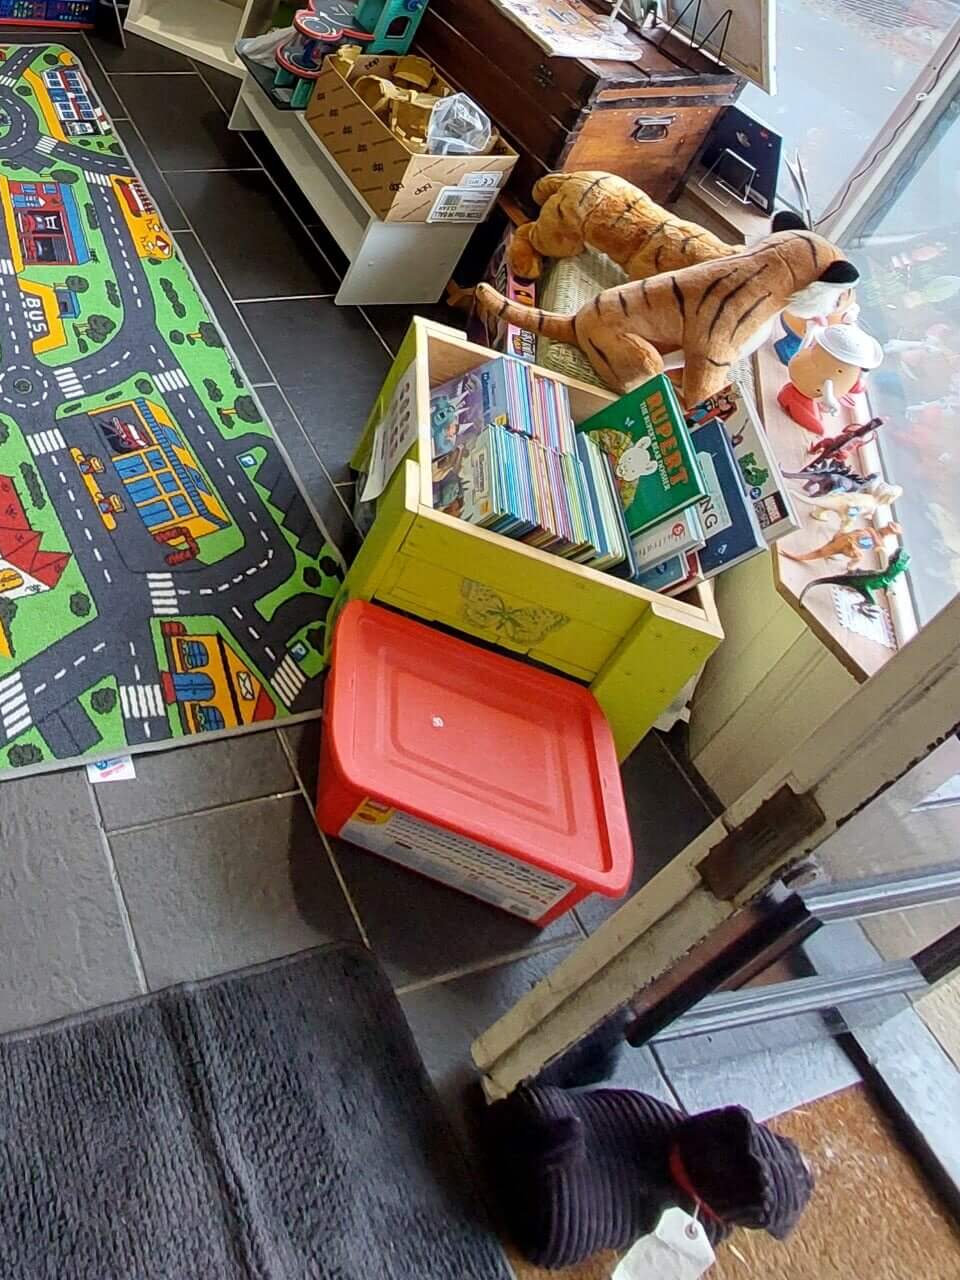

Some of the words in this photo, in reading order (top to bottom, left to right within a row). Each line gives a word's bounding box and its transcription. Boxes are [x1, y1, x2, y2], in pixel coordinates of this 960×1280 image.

[25, 297, 48, 333] BUS
[640, 401, 649, 417] THE
[643, 414, 656, 441] RUPERT
[646, 390, 689, 486] RUPERT
[651, 441, 662, 460] BEAR
